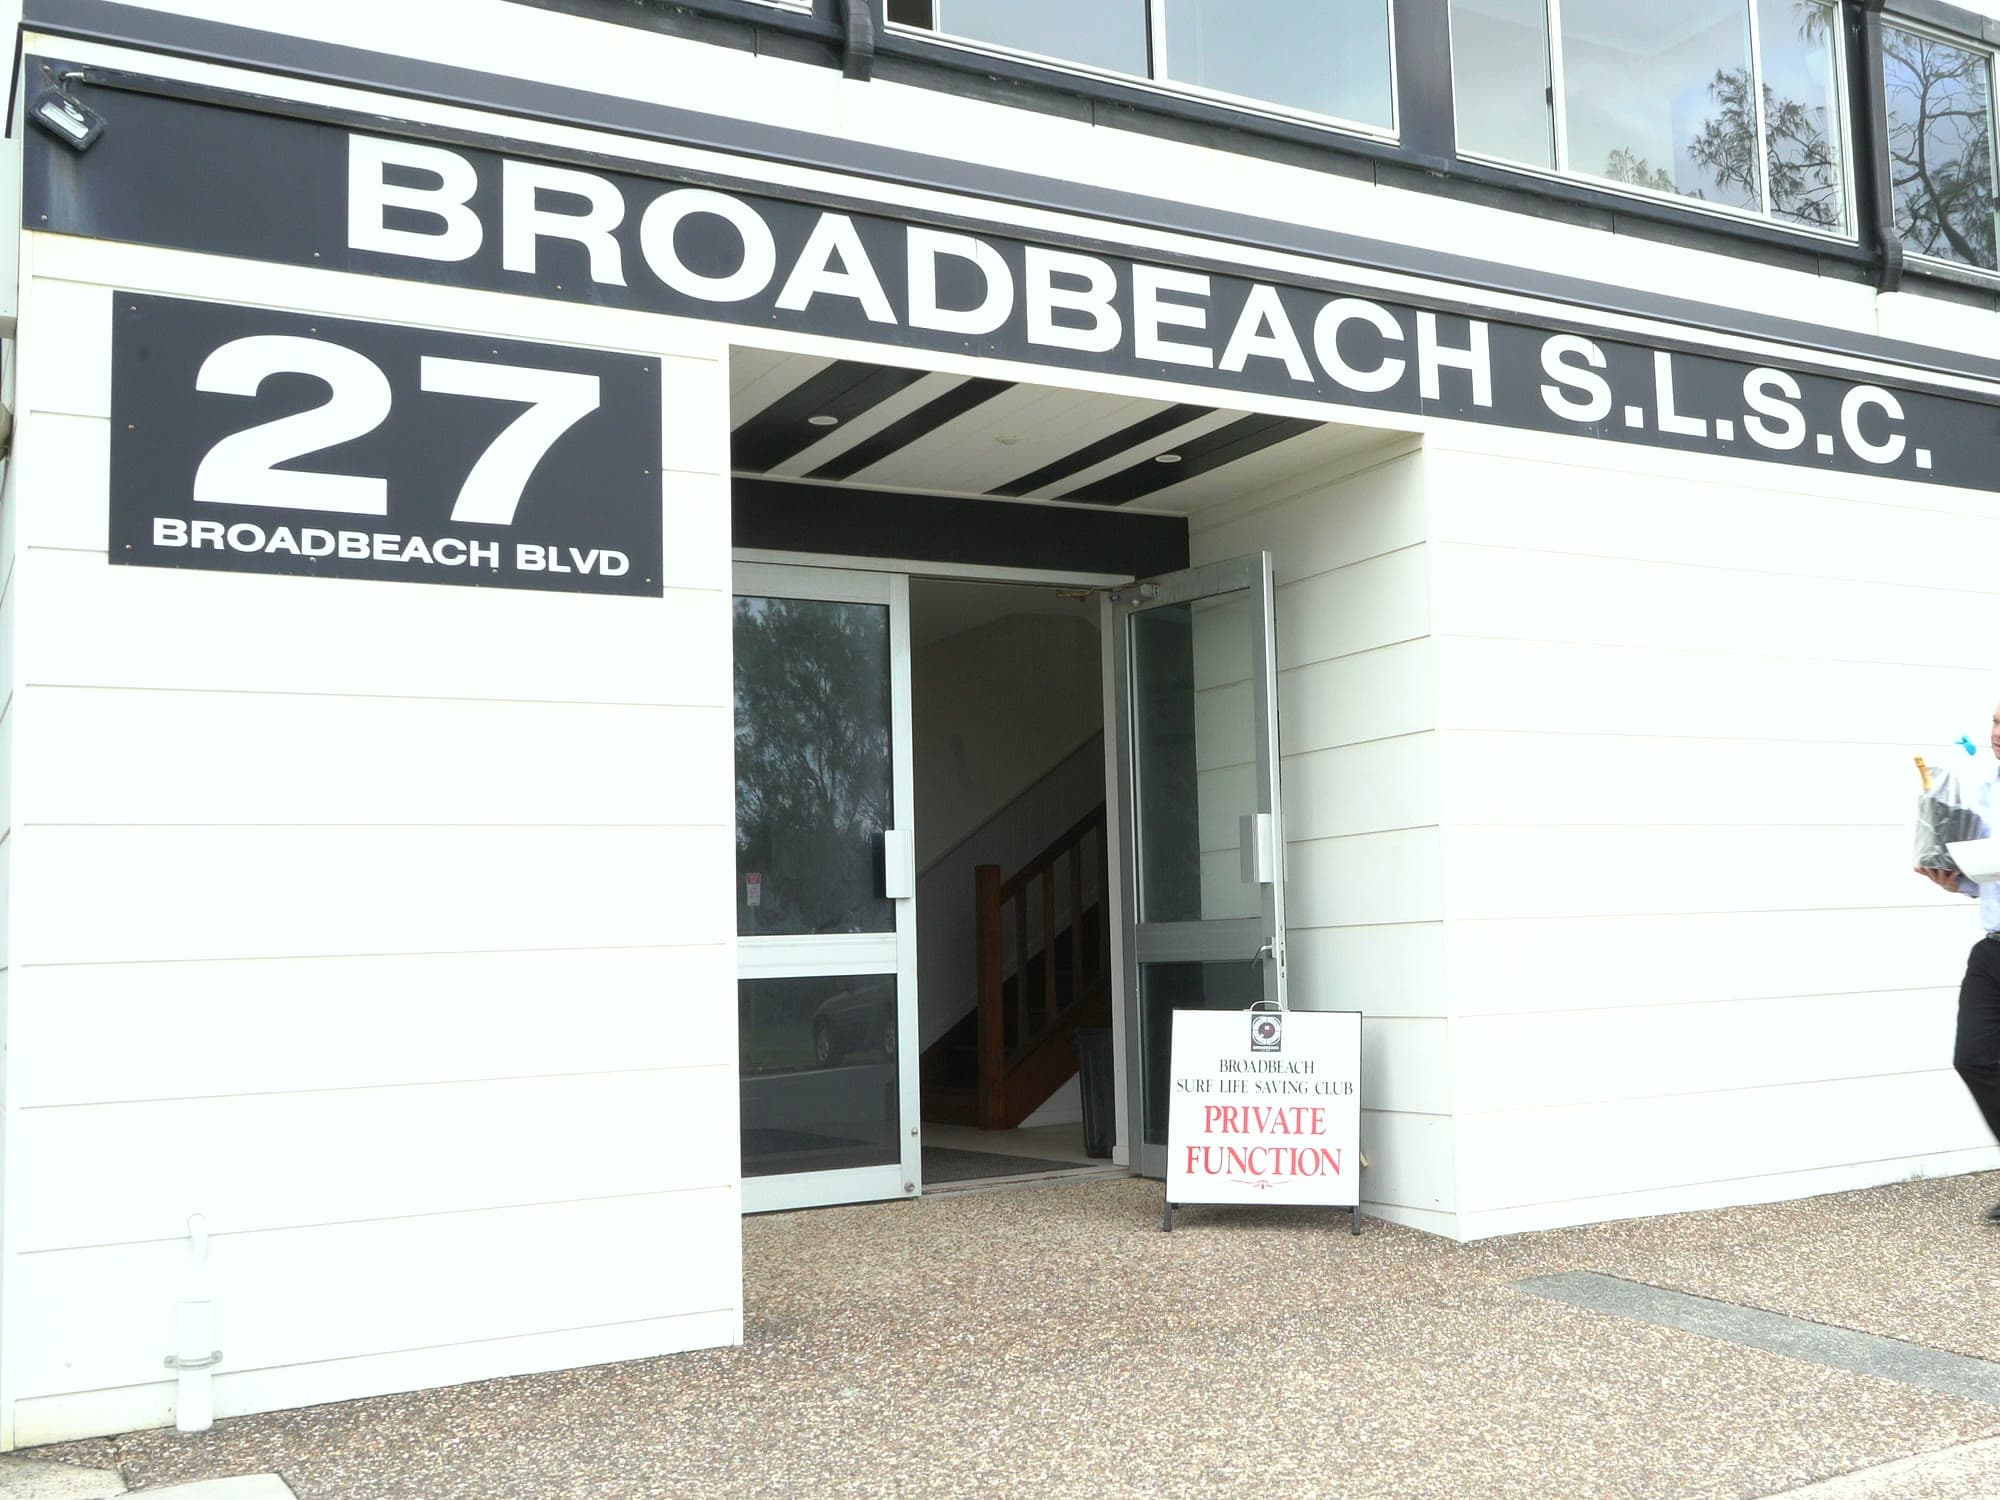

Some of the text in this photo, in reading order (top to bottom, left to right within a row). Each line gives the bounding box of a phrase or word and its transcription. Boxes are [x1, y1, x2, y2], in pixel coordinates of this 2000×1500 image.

[346, 133, 1933, 470] BROADBEACH S.L.S.C.
[193, 334, 601, 526] 27
[152, 517, 629, 577] BROADBEACH BLVD
[1219, 1058, 1315, 1075] BROADBEACH
[1176, 1078, 1353, 1096] SURF LIFE SAVING CLUB
[1204, 1105, 1326, 1135] PRIVATE
[1186, 1145, 1343, 1177] FUNCTION
